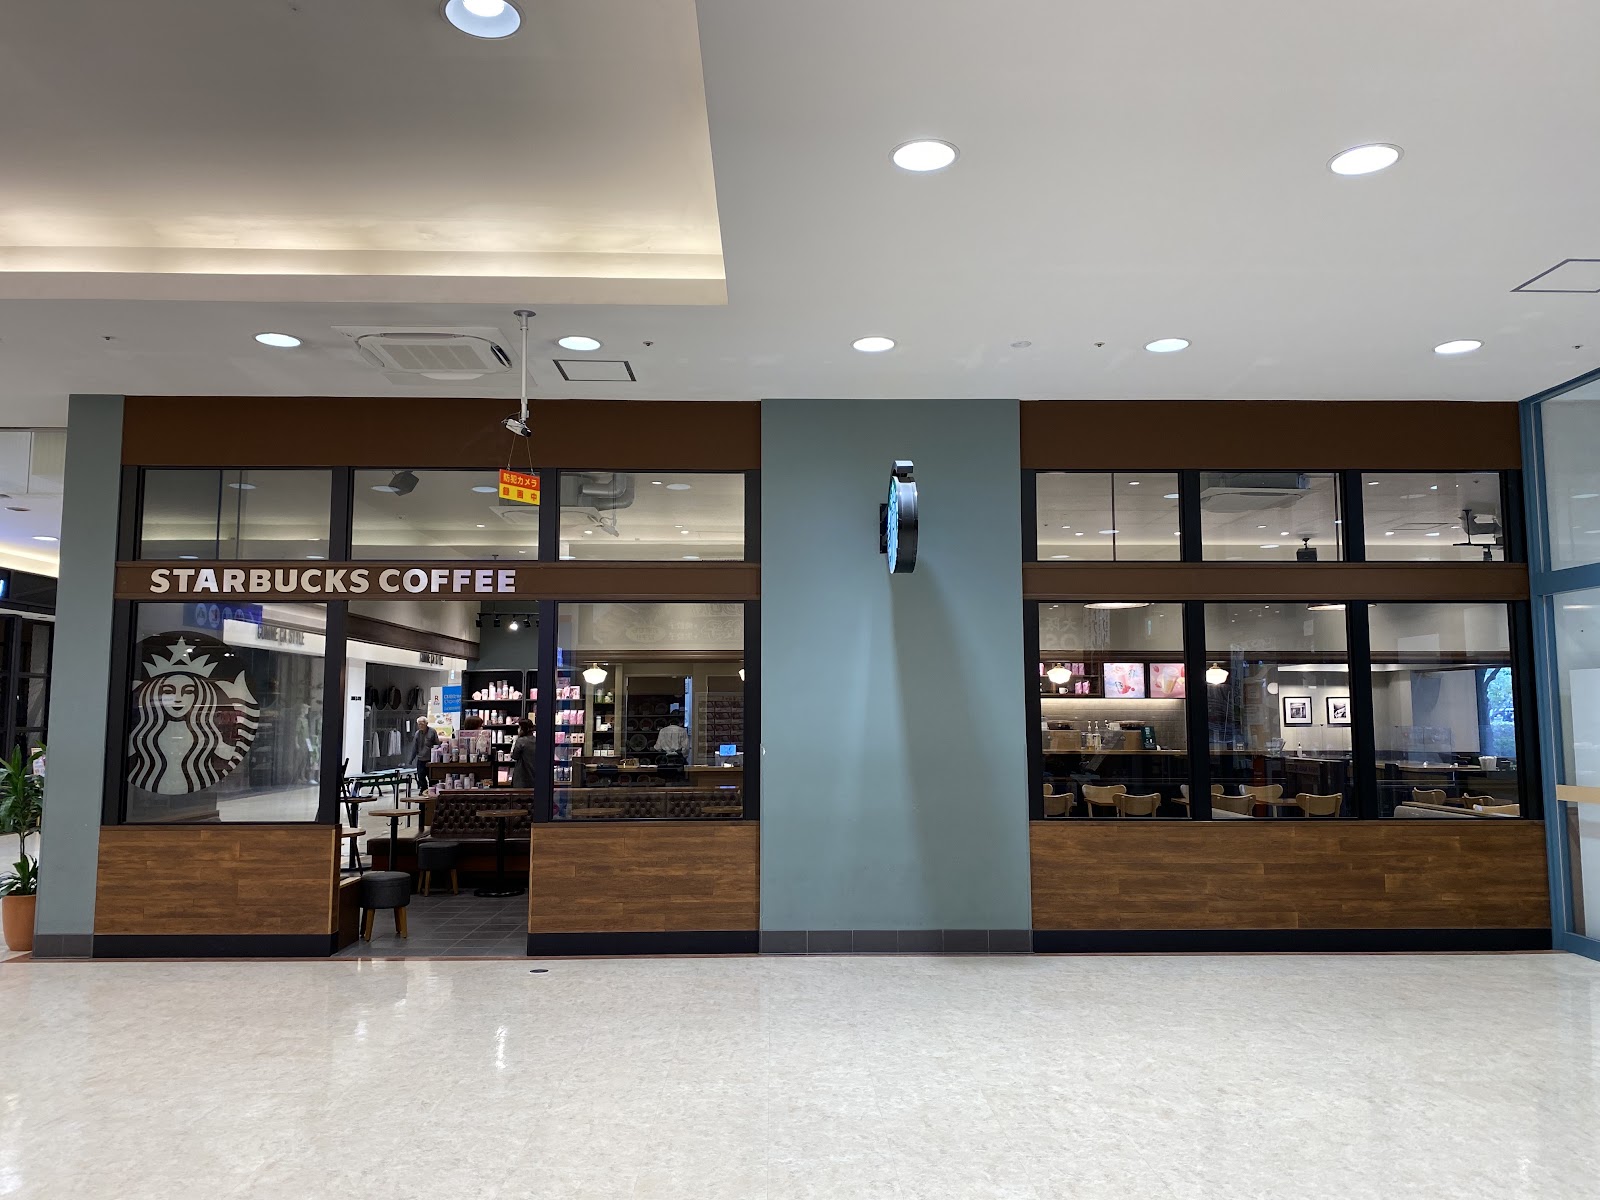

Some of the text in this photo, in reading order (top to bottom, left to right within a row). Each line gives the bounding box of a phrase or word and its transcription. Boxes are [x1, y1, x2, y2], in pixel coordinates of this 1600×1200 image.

[503, 472, 537, 488] 防犯カメラ
[150, 568, 516, 594] STARBUCKS COFFEE
